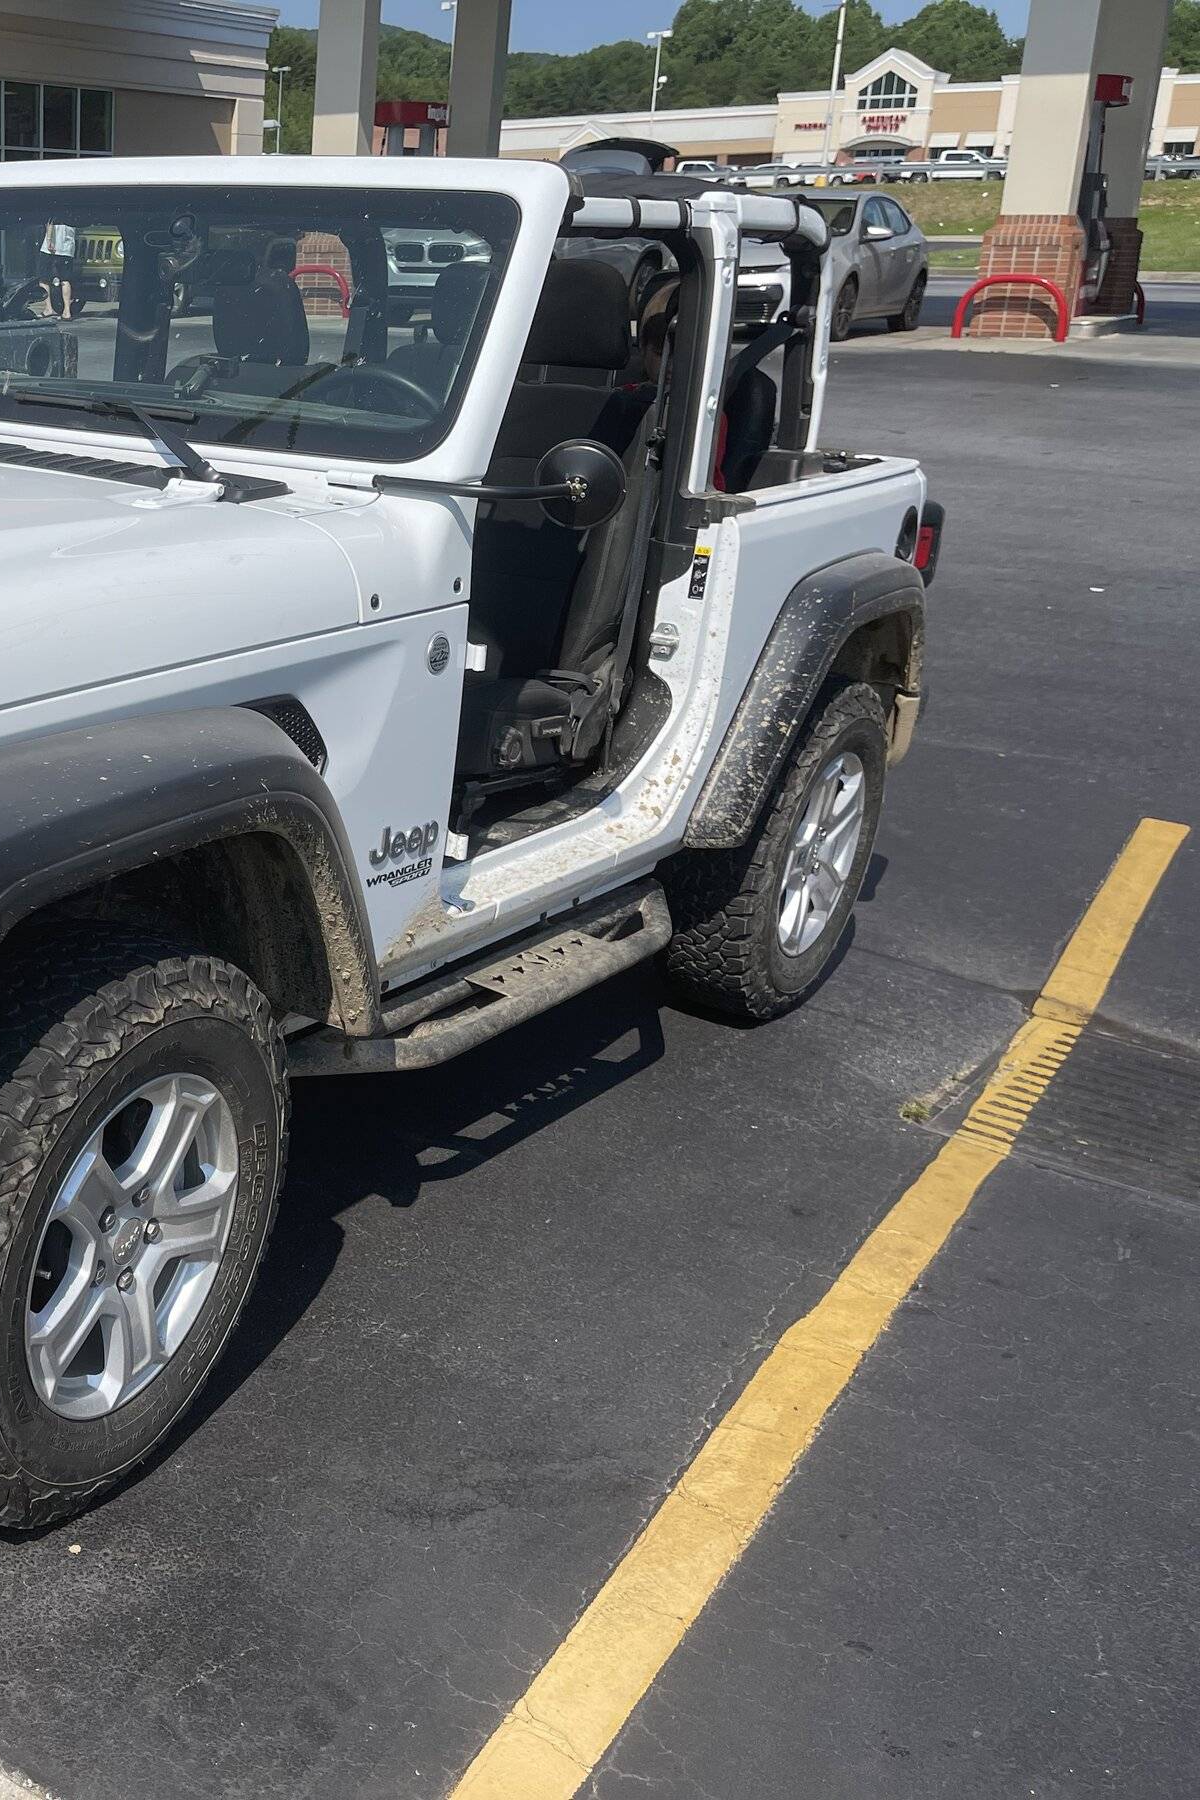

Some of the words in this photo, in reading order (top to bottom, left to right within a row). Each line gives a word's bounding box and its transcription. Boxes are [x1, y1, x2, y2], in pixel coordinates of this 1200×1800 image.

[369, 820, 439, 867] Jeep
[366, 858, 432, 888] WRANGLER
[389, 868, 431, 888] SPORT
